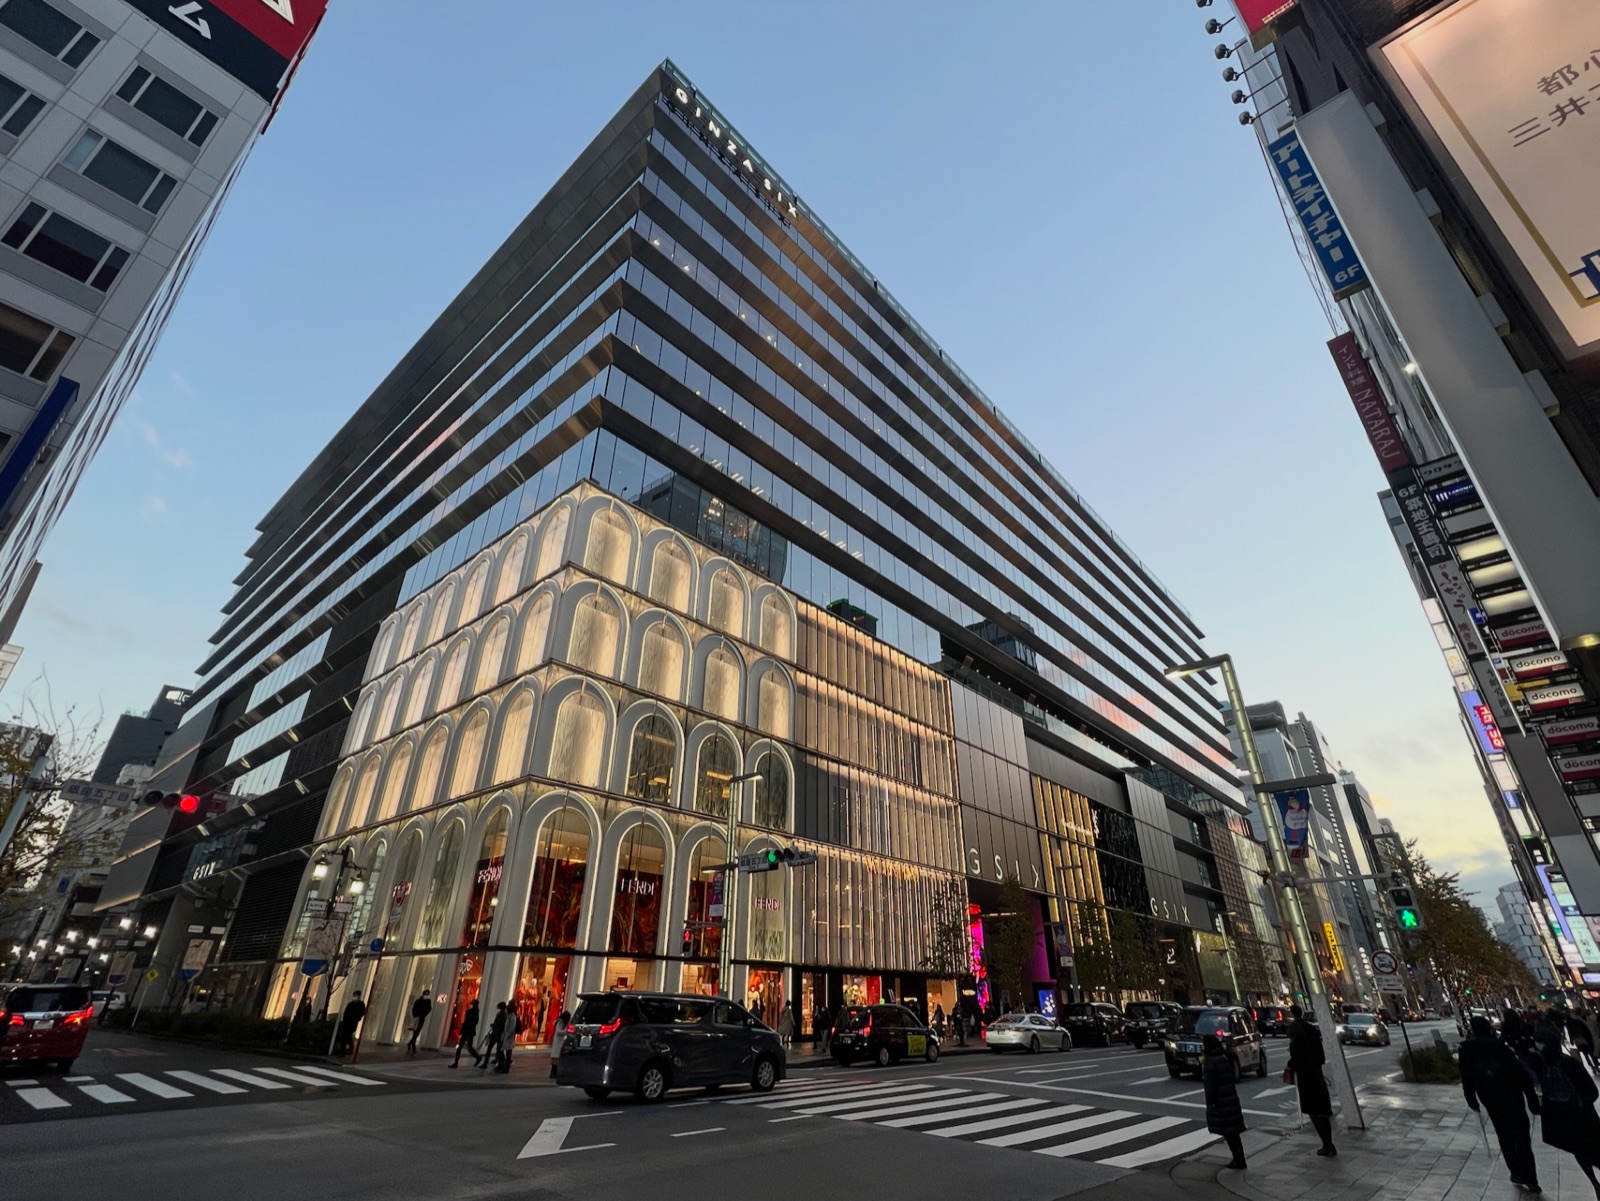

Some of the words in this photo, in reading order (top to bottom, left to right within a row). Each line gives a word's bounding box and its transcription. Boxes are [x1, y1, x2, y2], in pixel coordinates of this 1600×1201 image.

[675, 87, 754, 173] GINZA
[763, 178, 798, 218] SIX
[1334, 263, 1361, 284] 6F
[1354, 389, 1400, 459] NATARAJ
[1397, 484, 1418, 499] 6F
[1501, 624, 1545, 638] docomo
[1516, 655, 1561, 669] docomo
[1531, 687, 1577, 701] docomo
[1547, 720, 1595, 735] docomo
[67, 784, 129, 802] 銀座五丁目
[192, 861, 217, 880] GSIX
[620, 877, 655, 896] FENDI
[1149, 896, 1191, 924] GSIX
